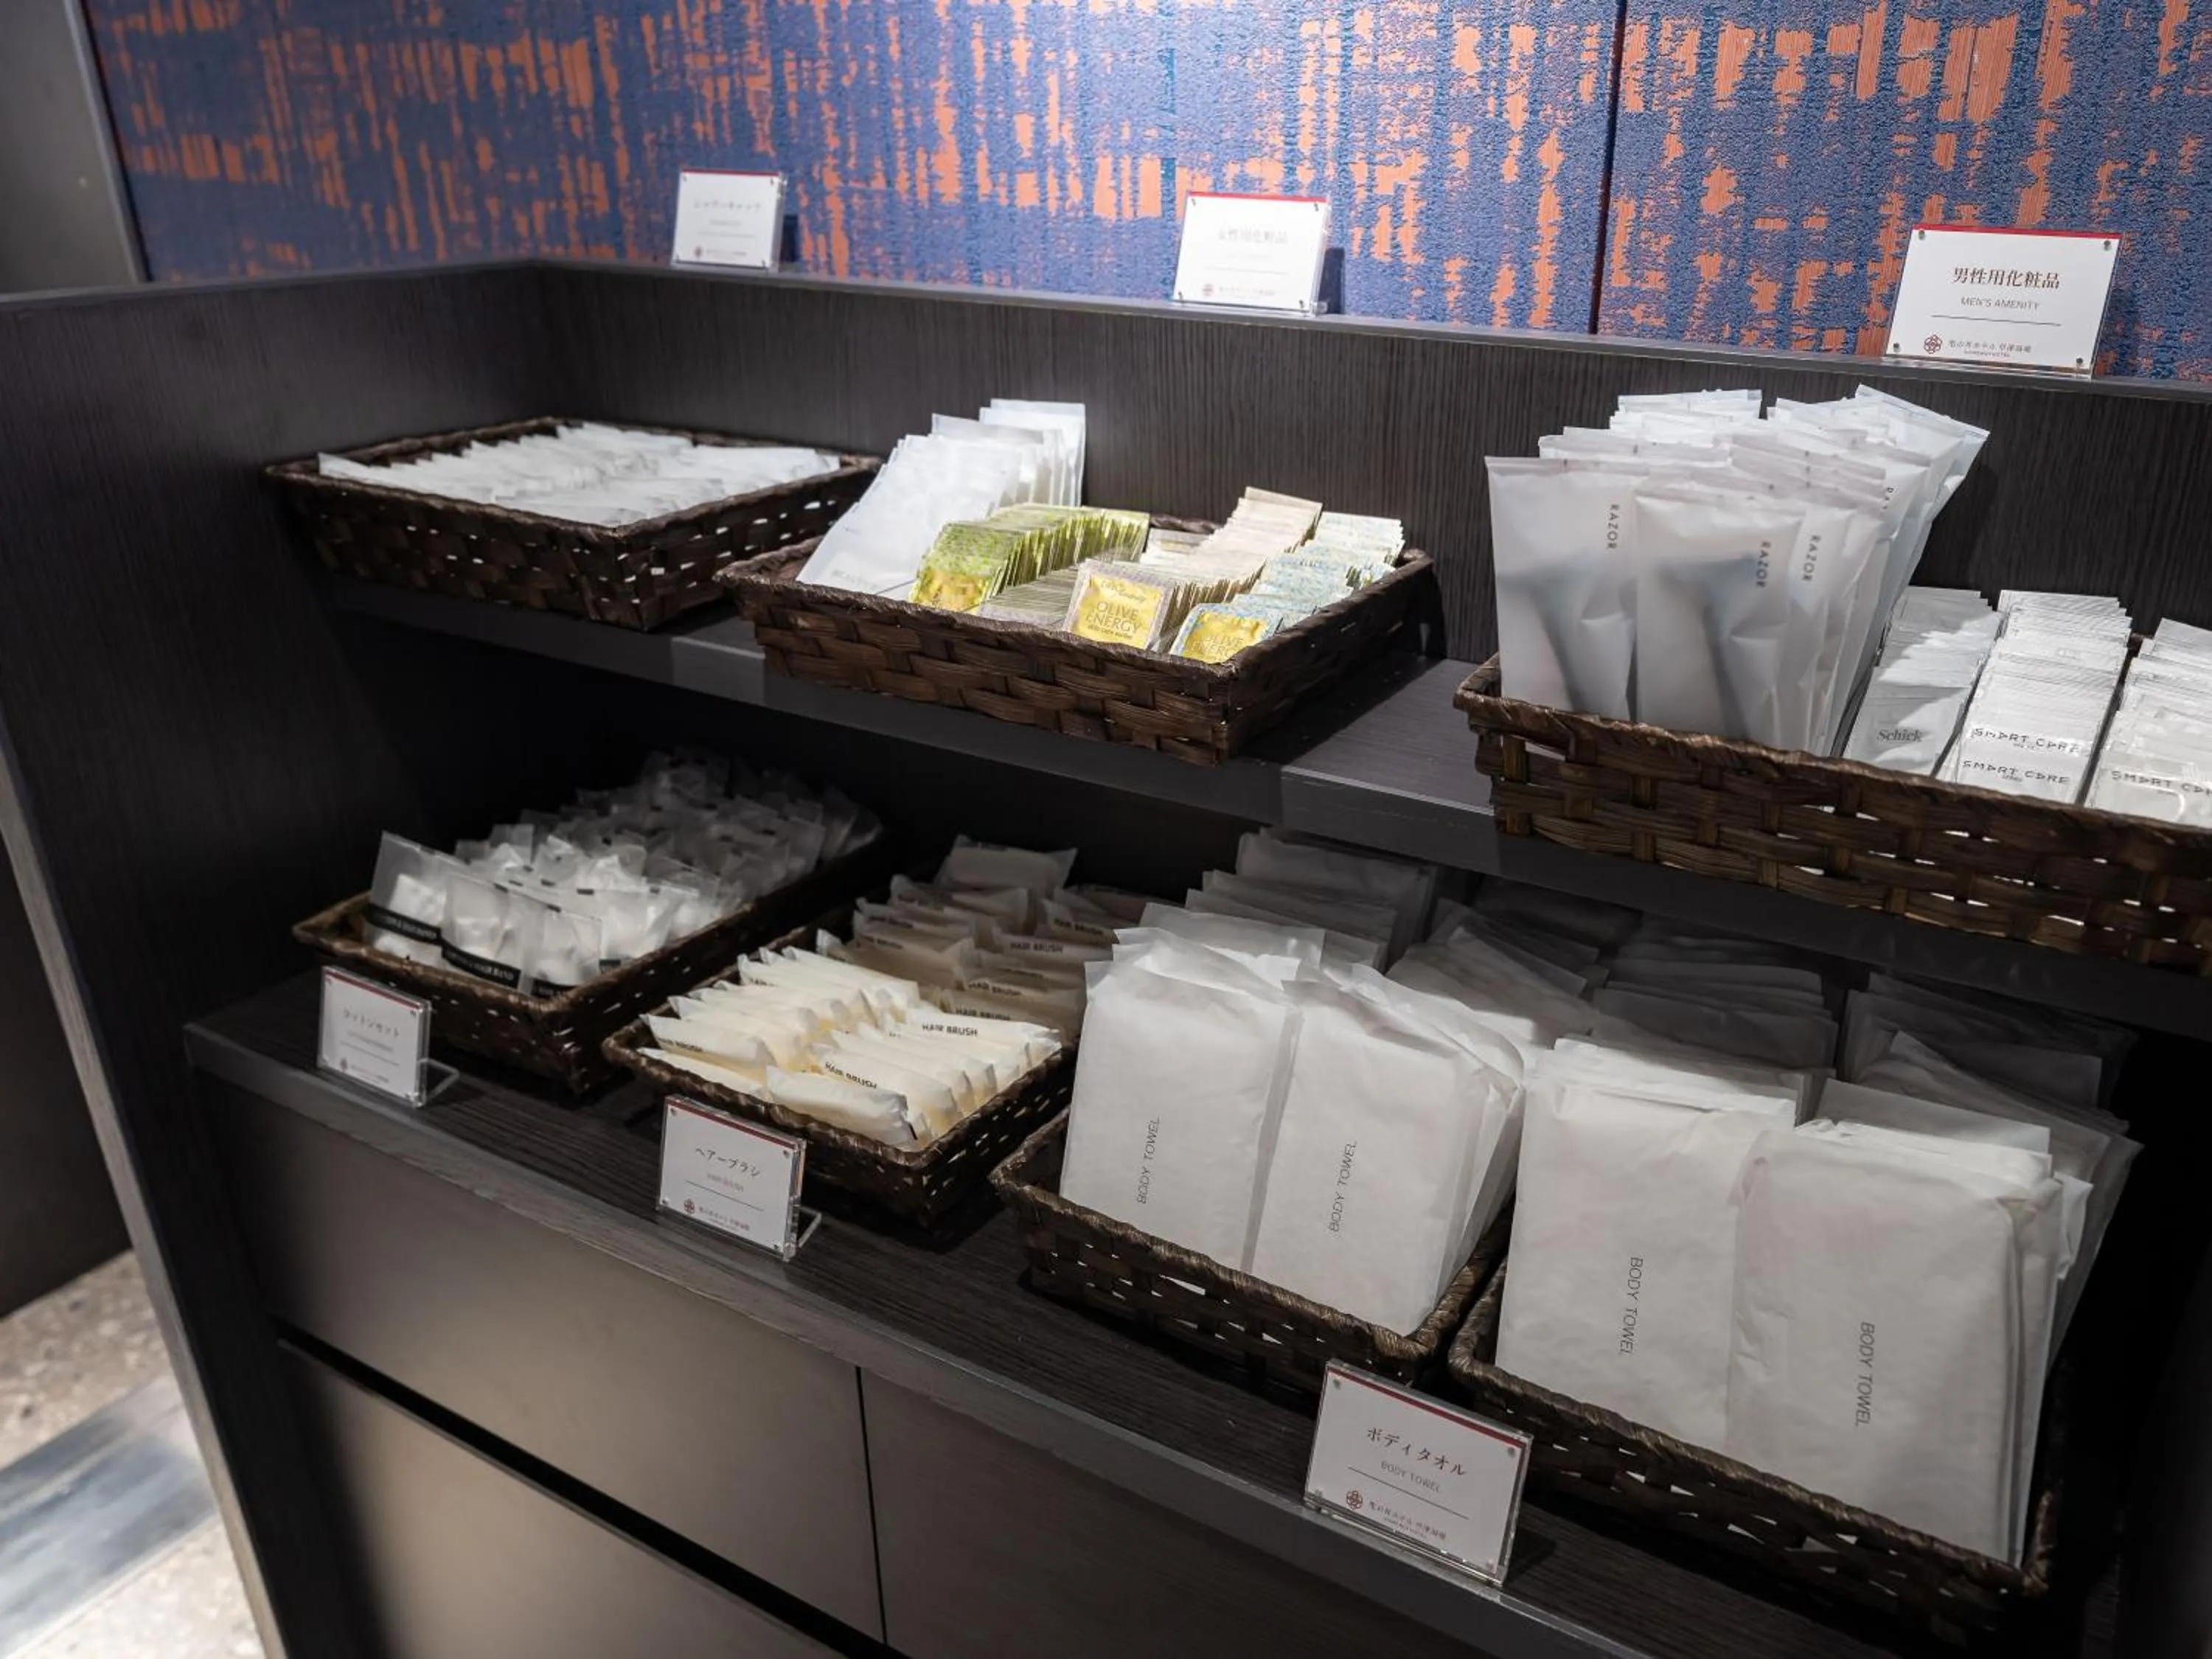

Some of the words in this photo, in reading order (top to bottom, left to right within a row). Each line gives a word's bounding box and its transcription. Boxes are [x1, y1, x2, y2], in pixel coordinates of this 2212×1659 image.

[1953, 266, 2061, 289] 男性用化粧品
[1961, 296, 1992, 307] MEN'S
[1994, 297, 2040, 310] AMENITY
[1607, 504, 1620, 550] RAZOR
[1756, 541, 1771, 588] RAZOR
[1801, 535, 1821, 582] RAZOR
[1085, 611, 1142, 633] ENERGY
[1097, 601, 1139, 621] OLIVE
[1879, 728, 1924, 742] Schick
[922, 1023, 944, 1033] HAIR
[946, 1026, 978, 1037] BRUSH
[1144, 1115, 1160, 1160] TOWEL
[695, 1147, 761, 1177] ヘアーブラシ
[1137, 1166, 1152, 1204] BODY
[1328, 1194, 1345, 1232] BODY
[1338, 1141, 1357, 1186] TOWEL
[1627, 1256, 1644, 1302] BODY
[1858, 1321, 1875, 1368] BODY
[1854, 1374, 1874, 1427] TOWEL
[1366, 1427, 1466, 1475] ボディタオル
[1381, 1461, 1408, 1478] BODY
[1410, 1469, 1441, 1494] TOWEL
